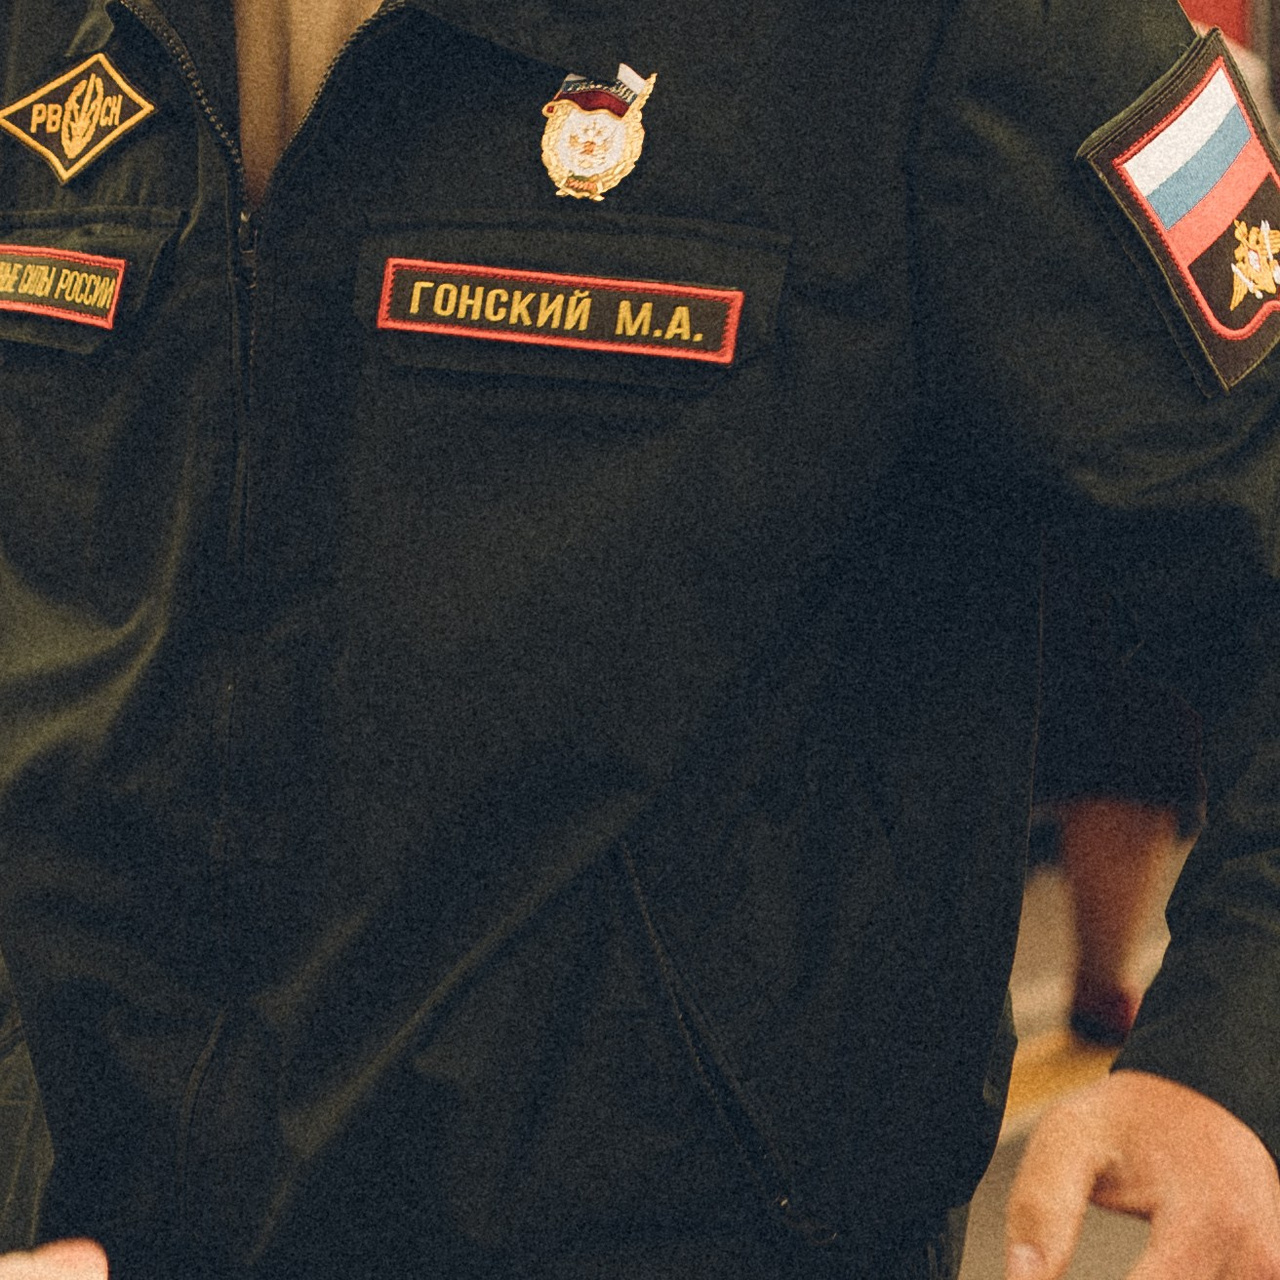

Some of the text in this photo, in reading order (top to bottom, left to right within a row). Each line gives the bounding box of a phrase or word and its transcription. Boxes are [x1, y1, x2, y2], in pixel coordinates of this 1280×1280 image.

[54, 269, 116, 308] РОССИИ
[410, 281, 703, 342] ГОНСКИЙ М.А.
